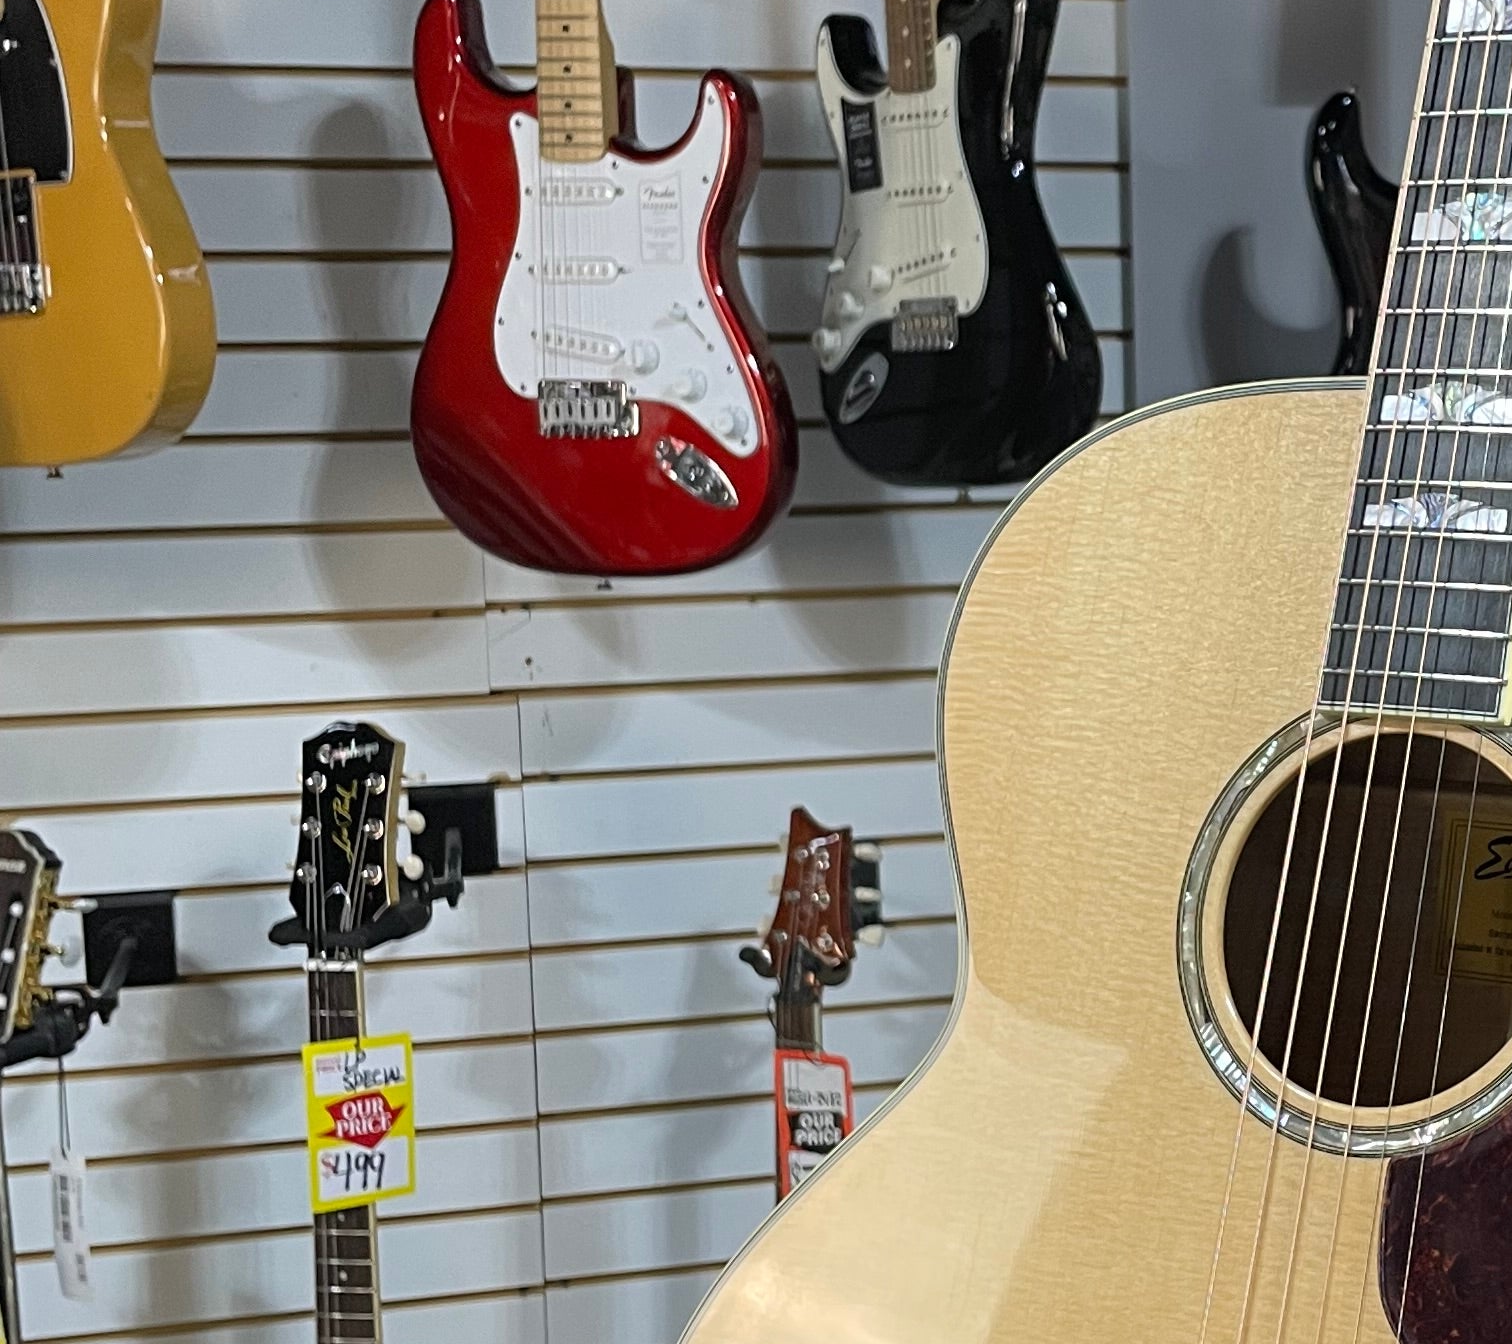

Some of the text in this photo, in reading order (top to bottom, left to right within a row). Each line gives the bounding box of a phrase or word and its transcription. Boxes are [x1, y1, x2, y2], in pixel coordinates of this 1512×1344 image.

[341, 1095, 385, 1120] OUR
[336, 1112, 393, 1138] PRICE
[799, 1112, 836, 1129] OUR
[794, 1127, 843, 1146] PRICE
[321, 1150, 386, 1192] $499
